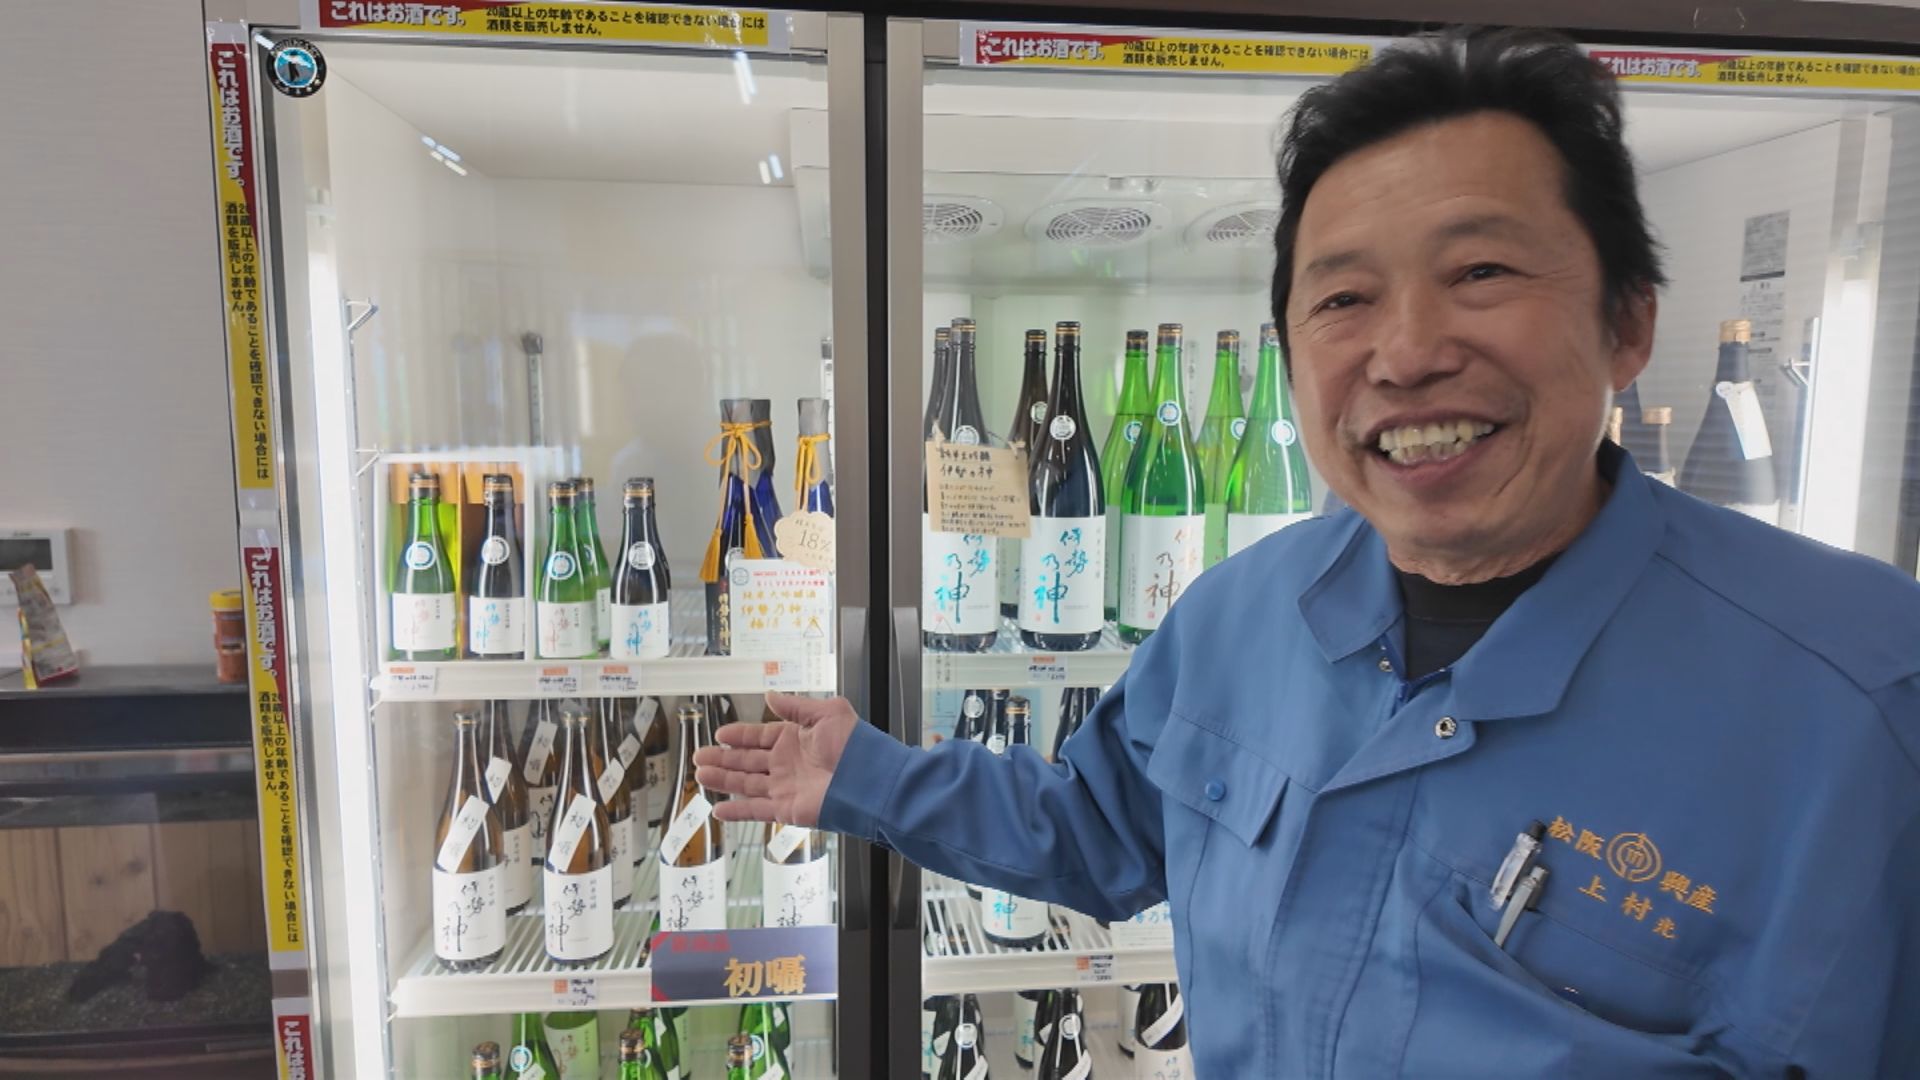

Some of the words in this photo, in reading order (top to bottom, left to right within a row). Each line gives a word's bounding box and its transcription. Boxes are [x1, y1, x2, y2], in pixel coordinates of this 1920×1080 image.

[331, 1, 465, 26] これはお酒です。
[486, 19, 602, 35] 酒類を販売しません。
[988, 36, 1105, 60] これはお酒です。
[1122, 40, 1369, 60] 20歳以上の年齢であることを確認できない場合には
[1122, 53, 1225, 68] 酒類を販売しません。
[1717, 60, 1920, 76] 20歳以上の年齢であることを確認できない場合
[217, 50, 245, 187] これはお酒です。
[225, 202, 246, 318] 酒類を販売しません。
[251, 550, 278, 678] これはお酒です。
